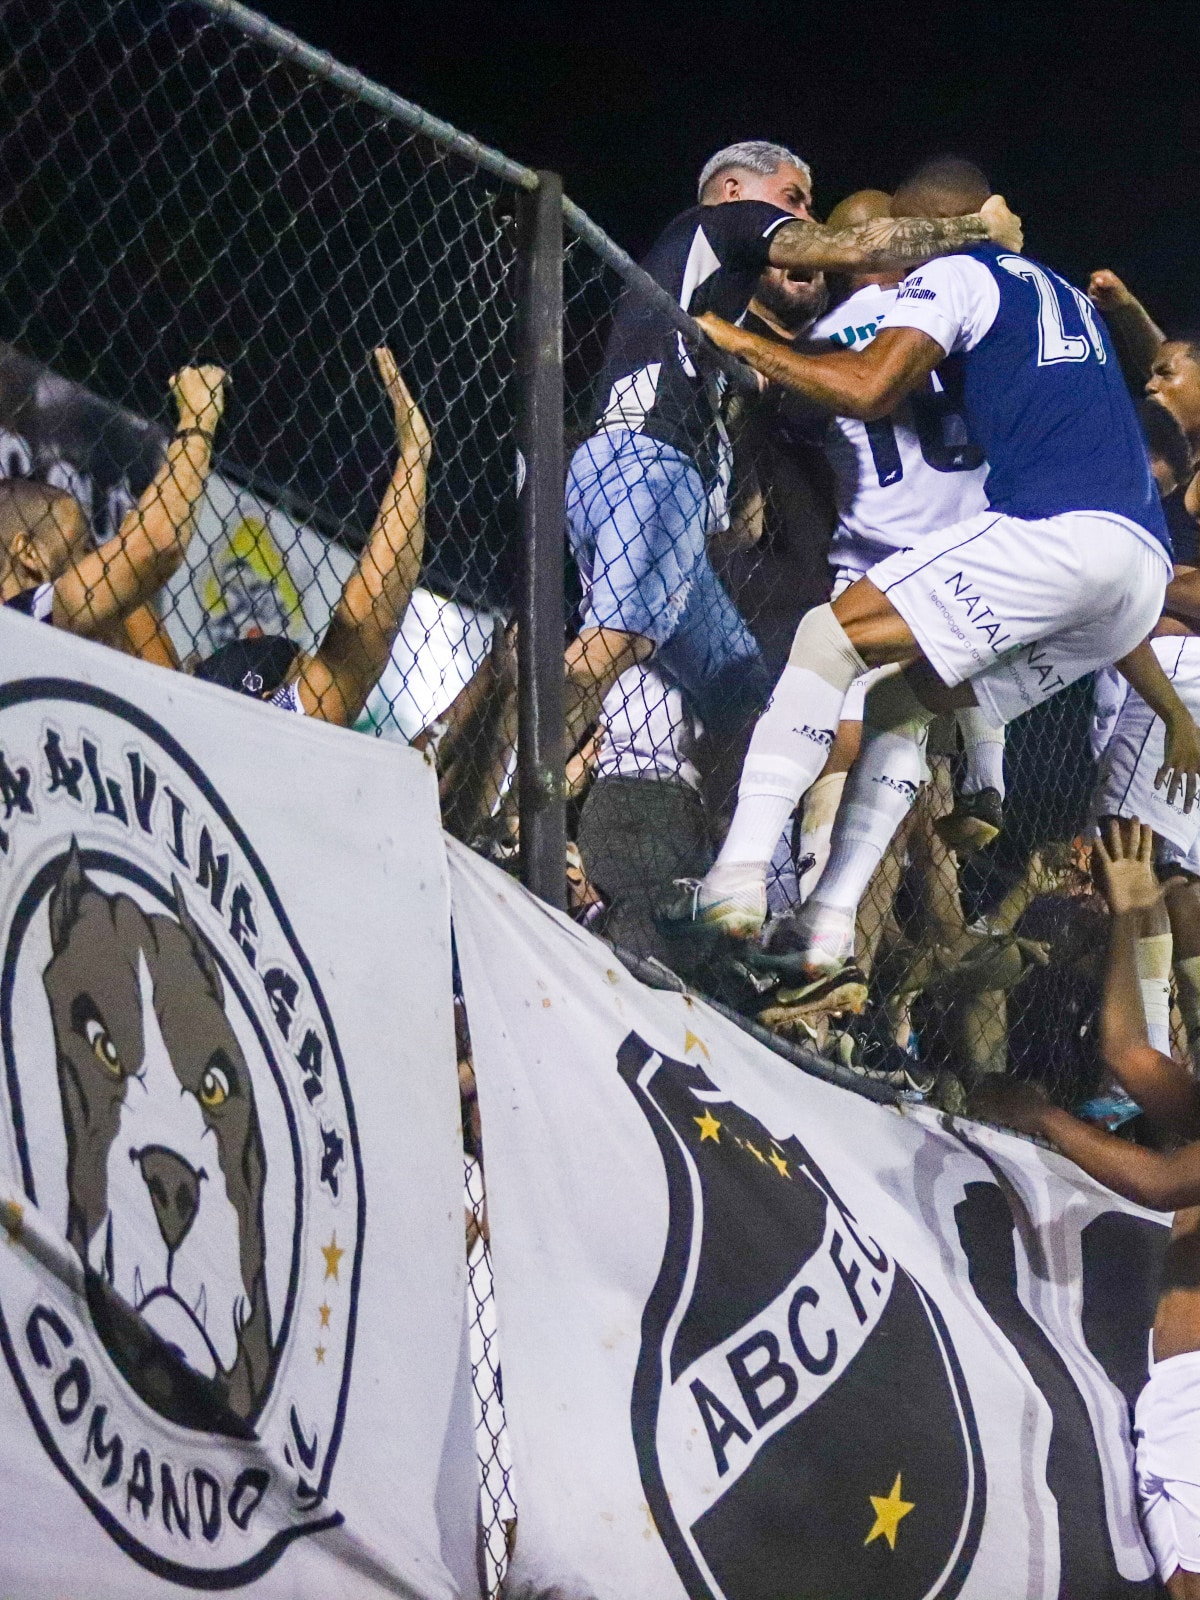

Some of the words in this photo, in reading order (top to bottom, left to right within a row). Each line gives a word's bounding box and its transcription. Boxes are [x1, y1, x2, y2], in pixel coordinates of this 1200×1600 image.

[944, 571, 1011, 654] NATAL
[1019, 641, 1065, 698] NAT
[26, 1305, 271, 1542] COMANDO
[689, 1285, 838, 1478] ABC
